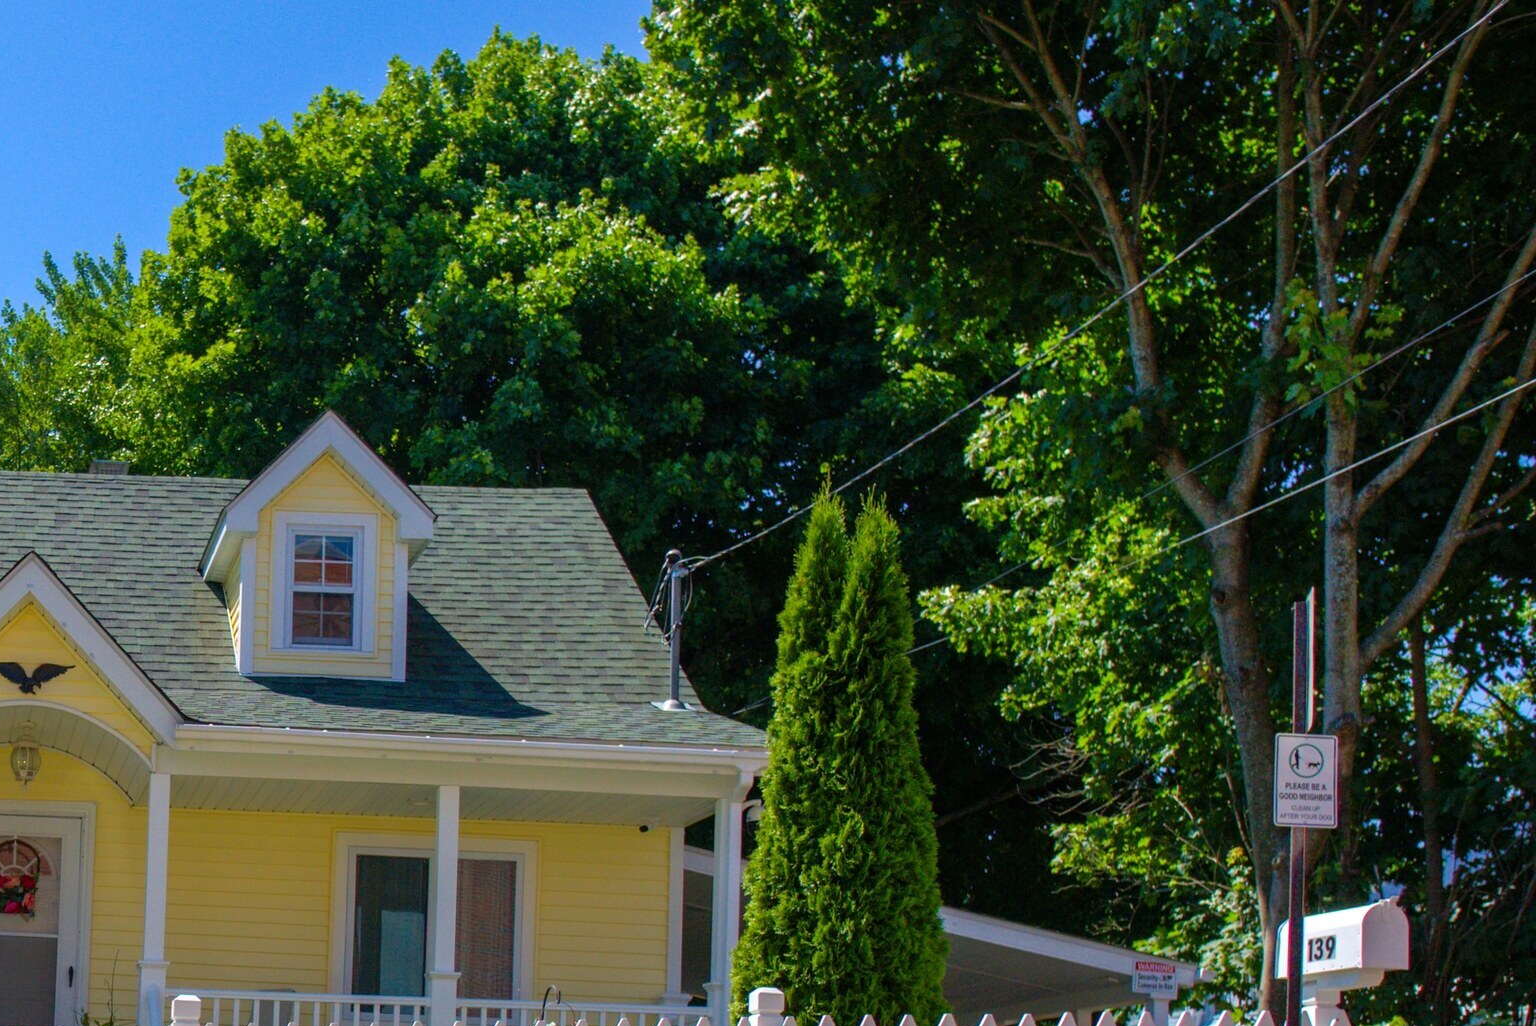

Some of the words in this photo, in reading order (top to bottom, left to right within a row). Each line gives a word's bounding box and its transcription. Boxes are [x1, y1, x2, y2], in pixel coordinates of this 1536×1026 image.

[1285, 782, 1310, 791] PLEASE
[1311, 783, 1320, 791] BE
[1321, 783, 1327, 791] A
[1278, 792, 1298, 801] GOOD
[1299, 792, 1333, 801] NEIGHBOR
[1307, 935, 1336, 962] 139
[1137, 962, 1174, 973] WARNING
[1137, 972, 1158, 982] Security
